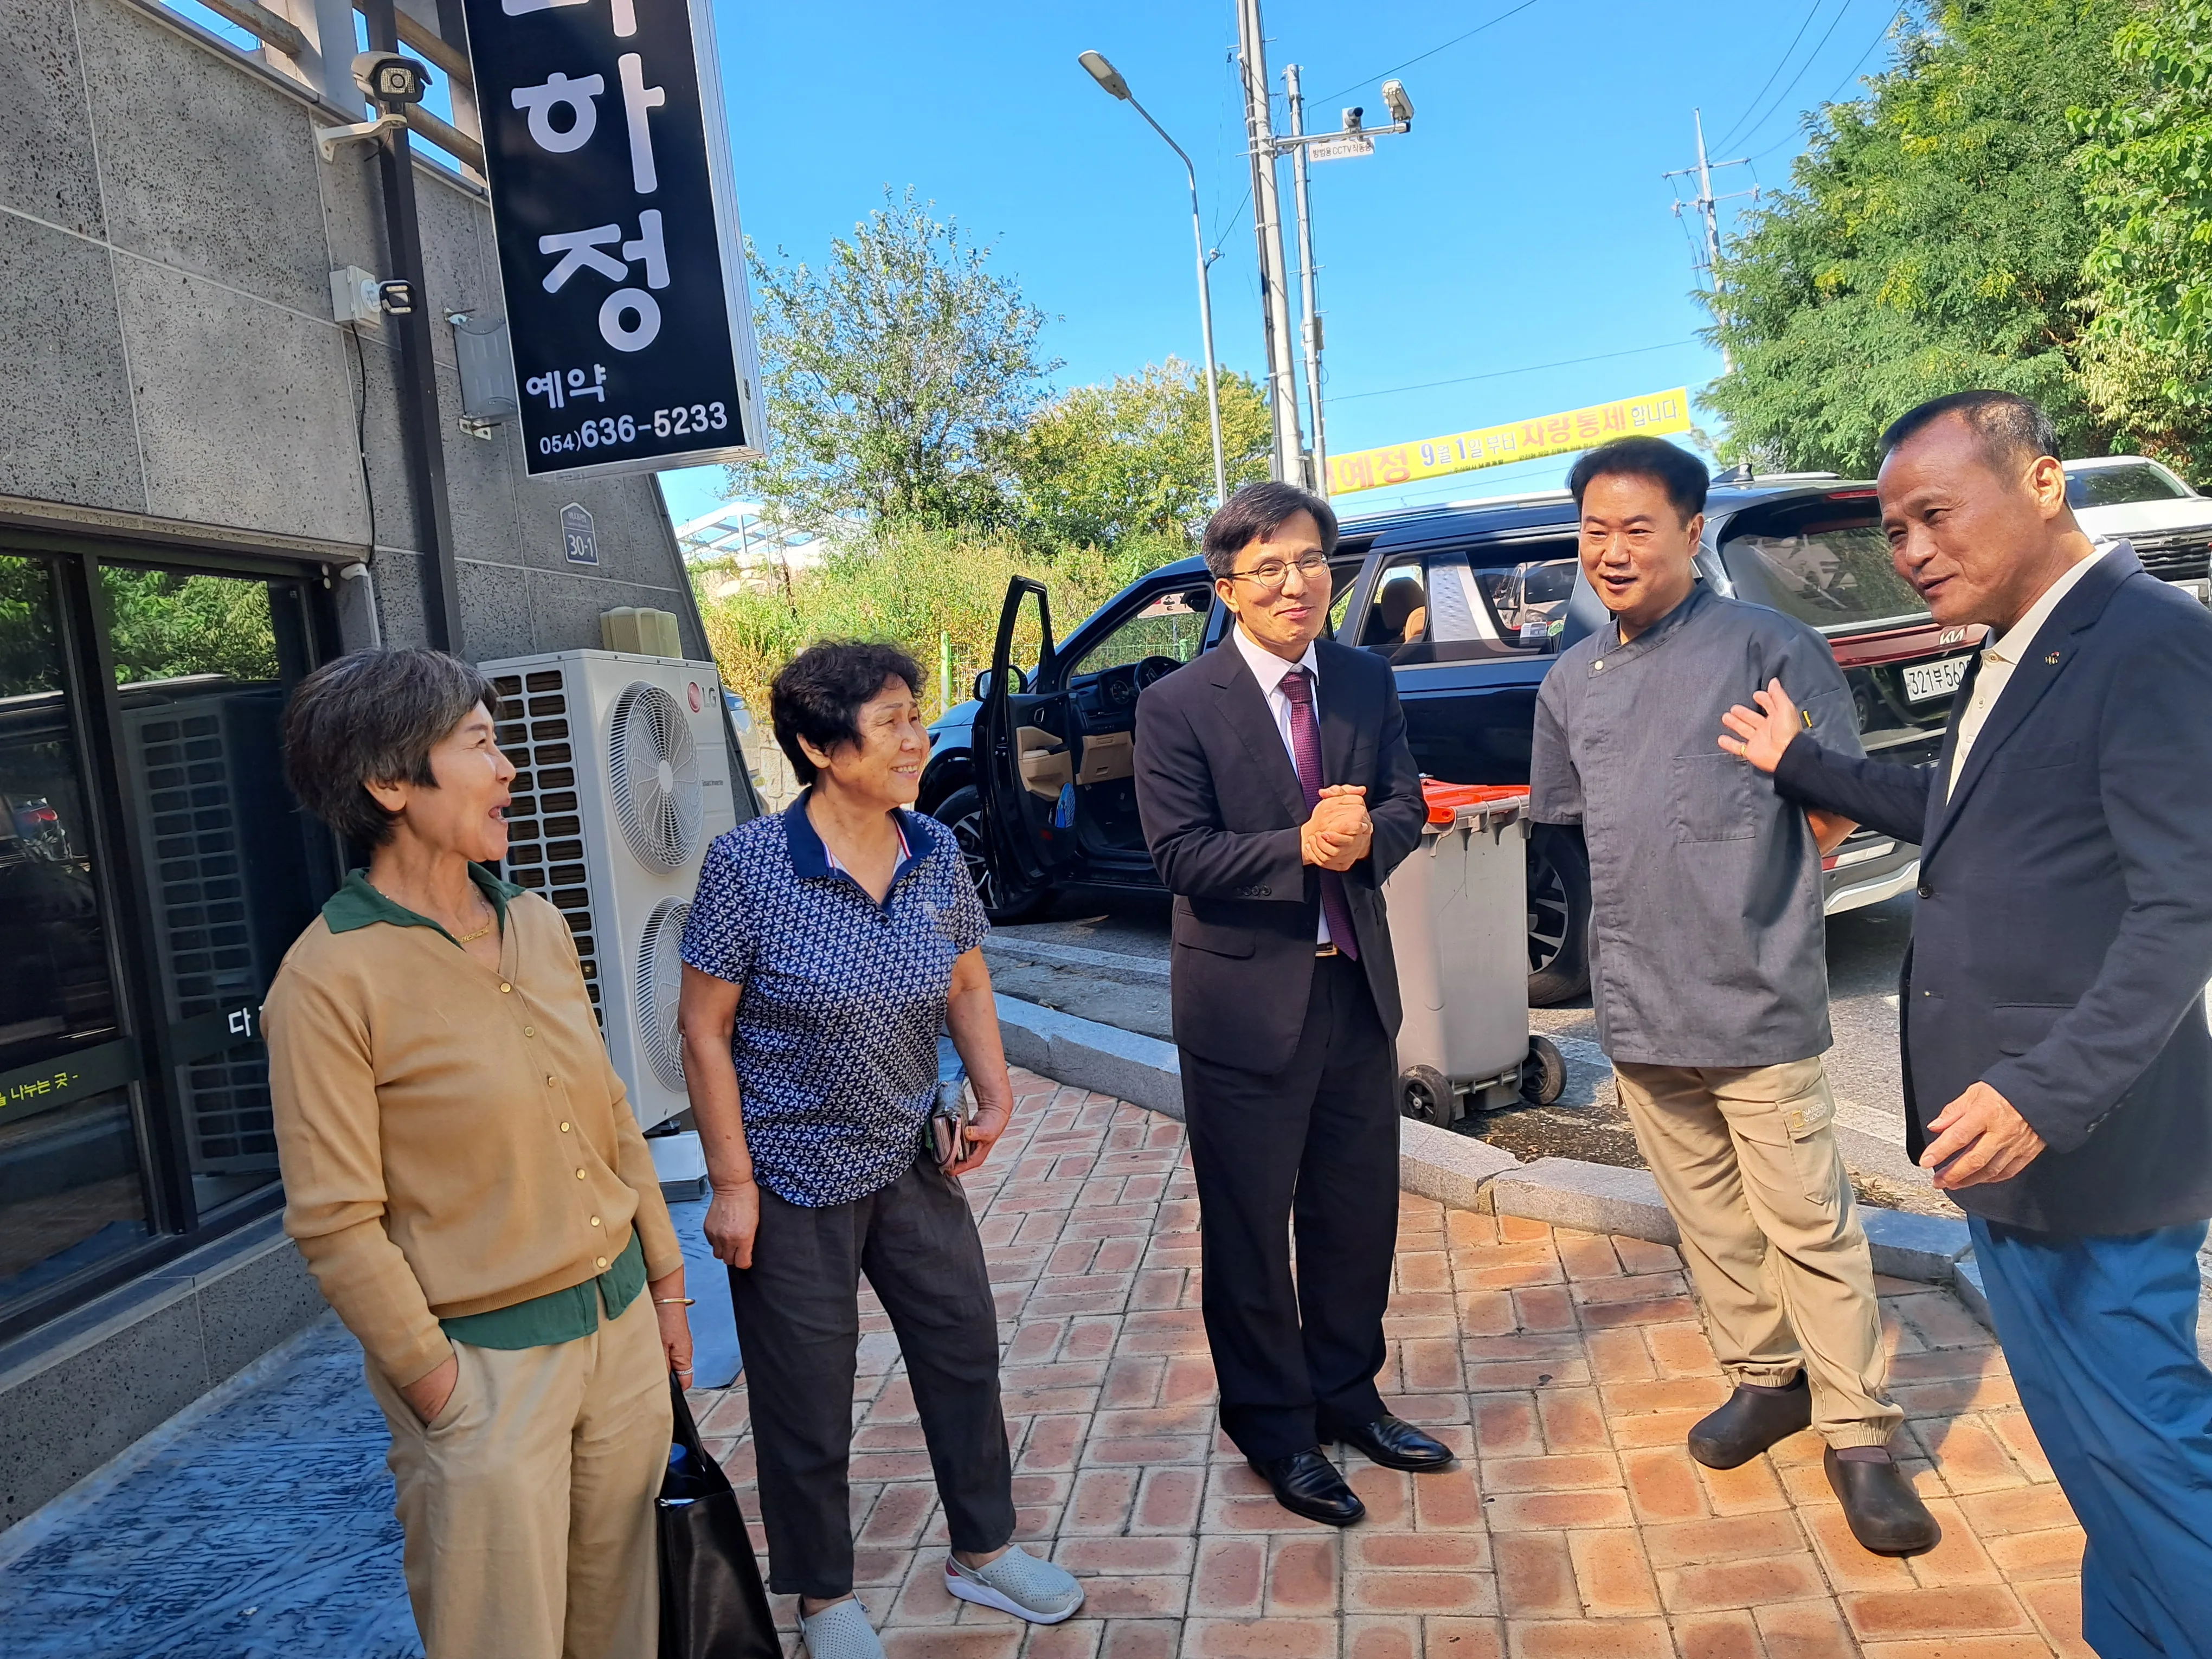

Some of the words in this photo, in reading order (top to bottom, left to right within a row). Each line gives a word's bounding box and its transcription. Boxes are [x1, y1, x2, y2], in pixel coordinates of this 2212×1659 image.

[1333, 145, 1352, 155] CCTV
[502, 0, 670, 352] 하정
[526, 364, 607, 409] 예약
[568, 534, 594, 558] 30-1
[702, 687, 717, 708] LG
[11, 1080, 51, 1101] 나누는
[54, 1072, 68, 1089] 곳
